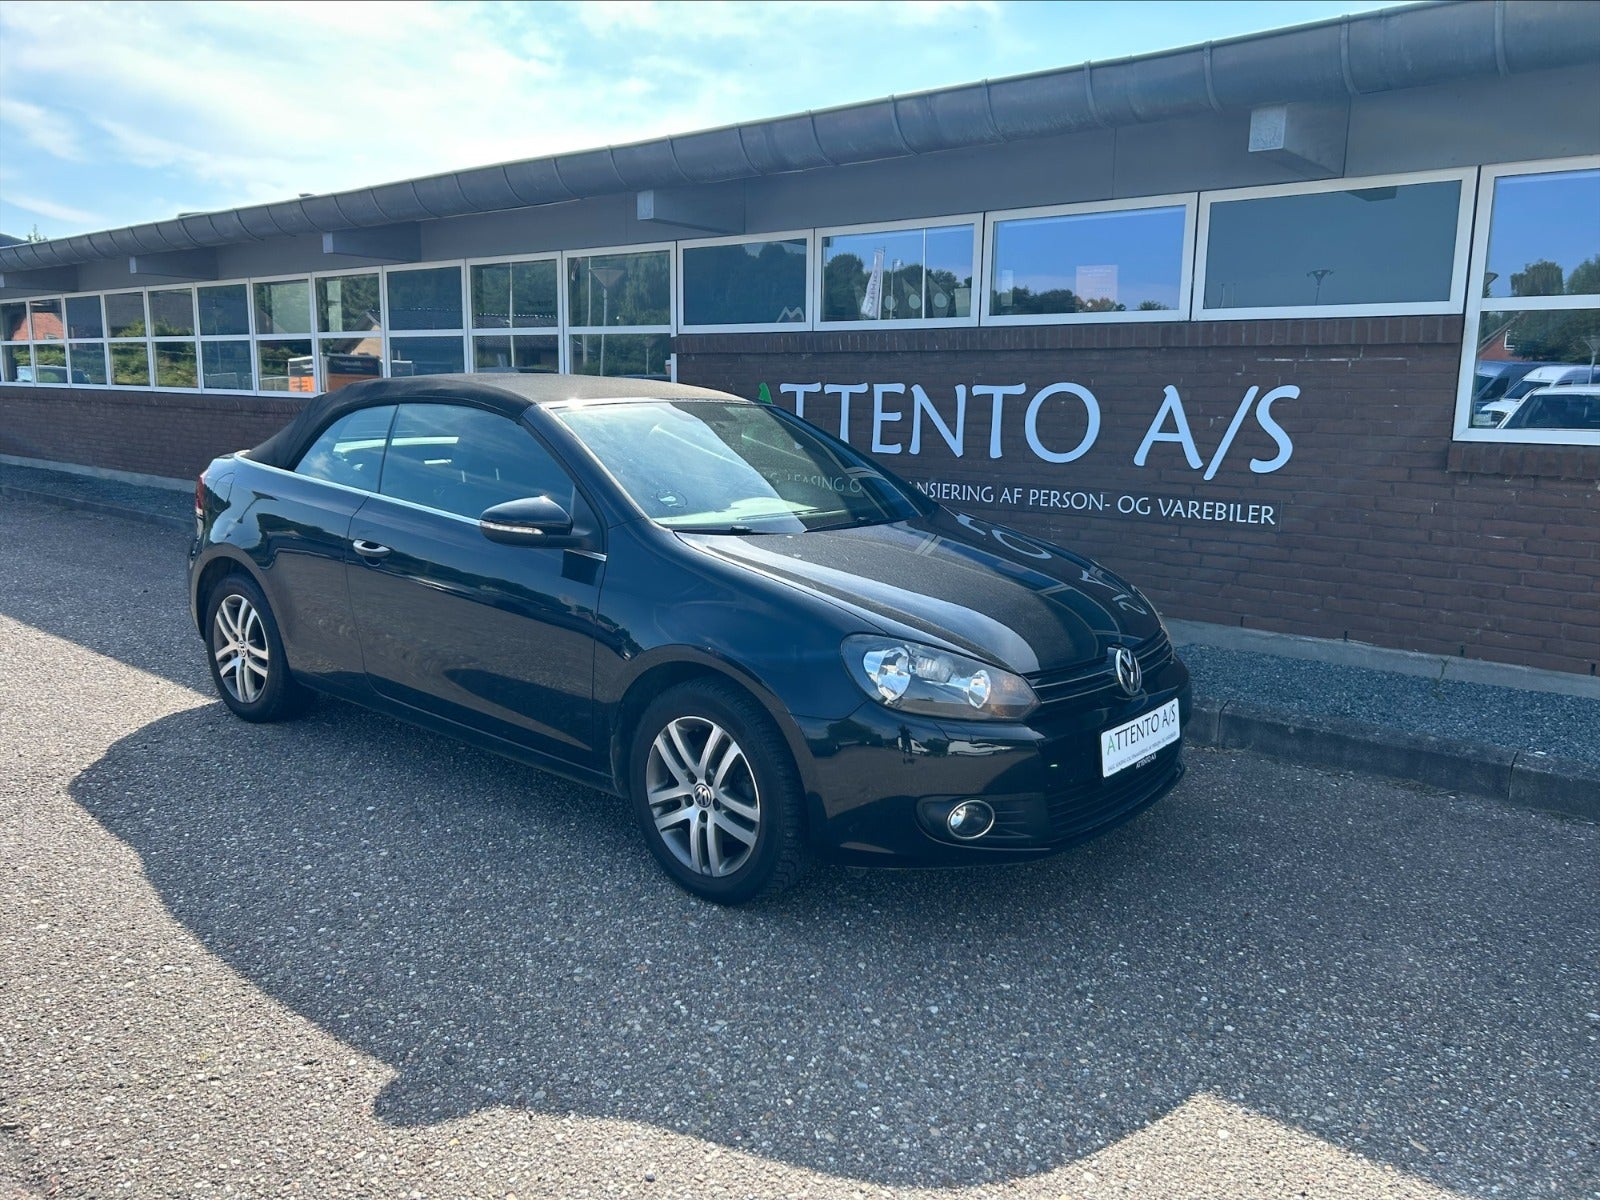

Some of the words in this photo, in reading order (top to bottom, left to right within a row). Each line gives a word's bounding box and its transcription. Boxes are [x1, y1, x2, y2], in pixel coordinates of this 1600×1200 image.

[758, 382, 1101, 464] TTENTO
[1133, 384, 1301, 481] A/S
[909, 480, 994, 503] NSIERING
[999, 486, 1023, 505] AF
[1028, 488, 1111, 512] PERSON-
[1117, 495, 1151, 515] OG
[1157, 497, 1276, 525] VAREBILER
[1106, 713, 1160, 756] ATTENTO
[1161, 703, 1176, 728] A/S
